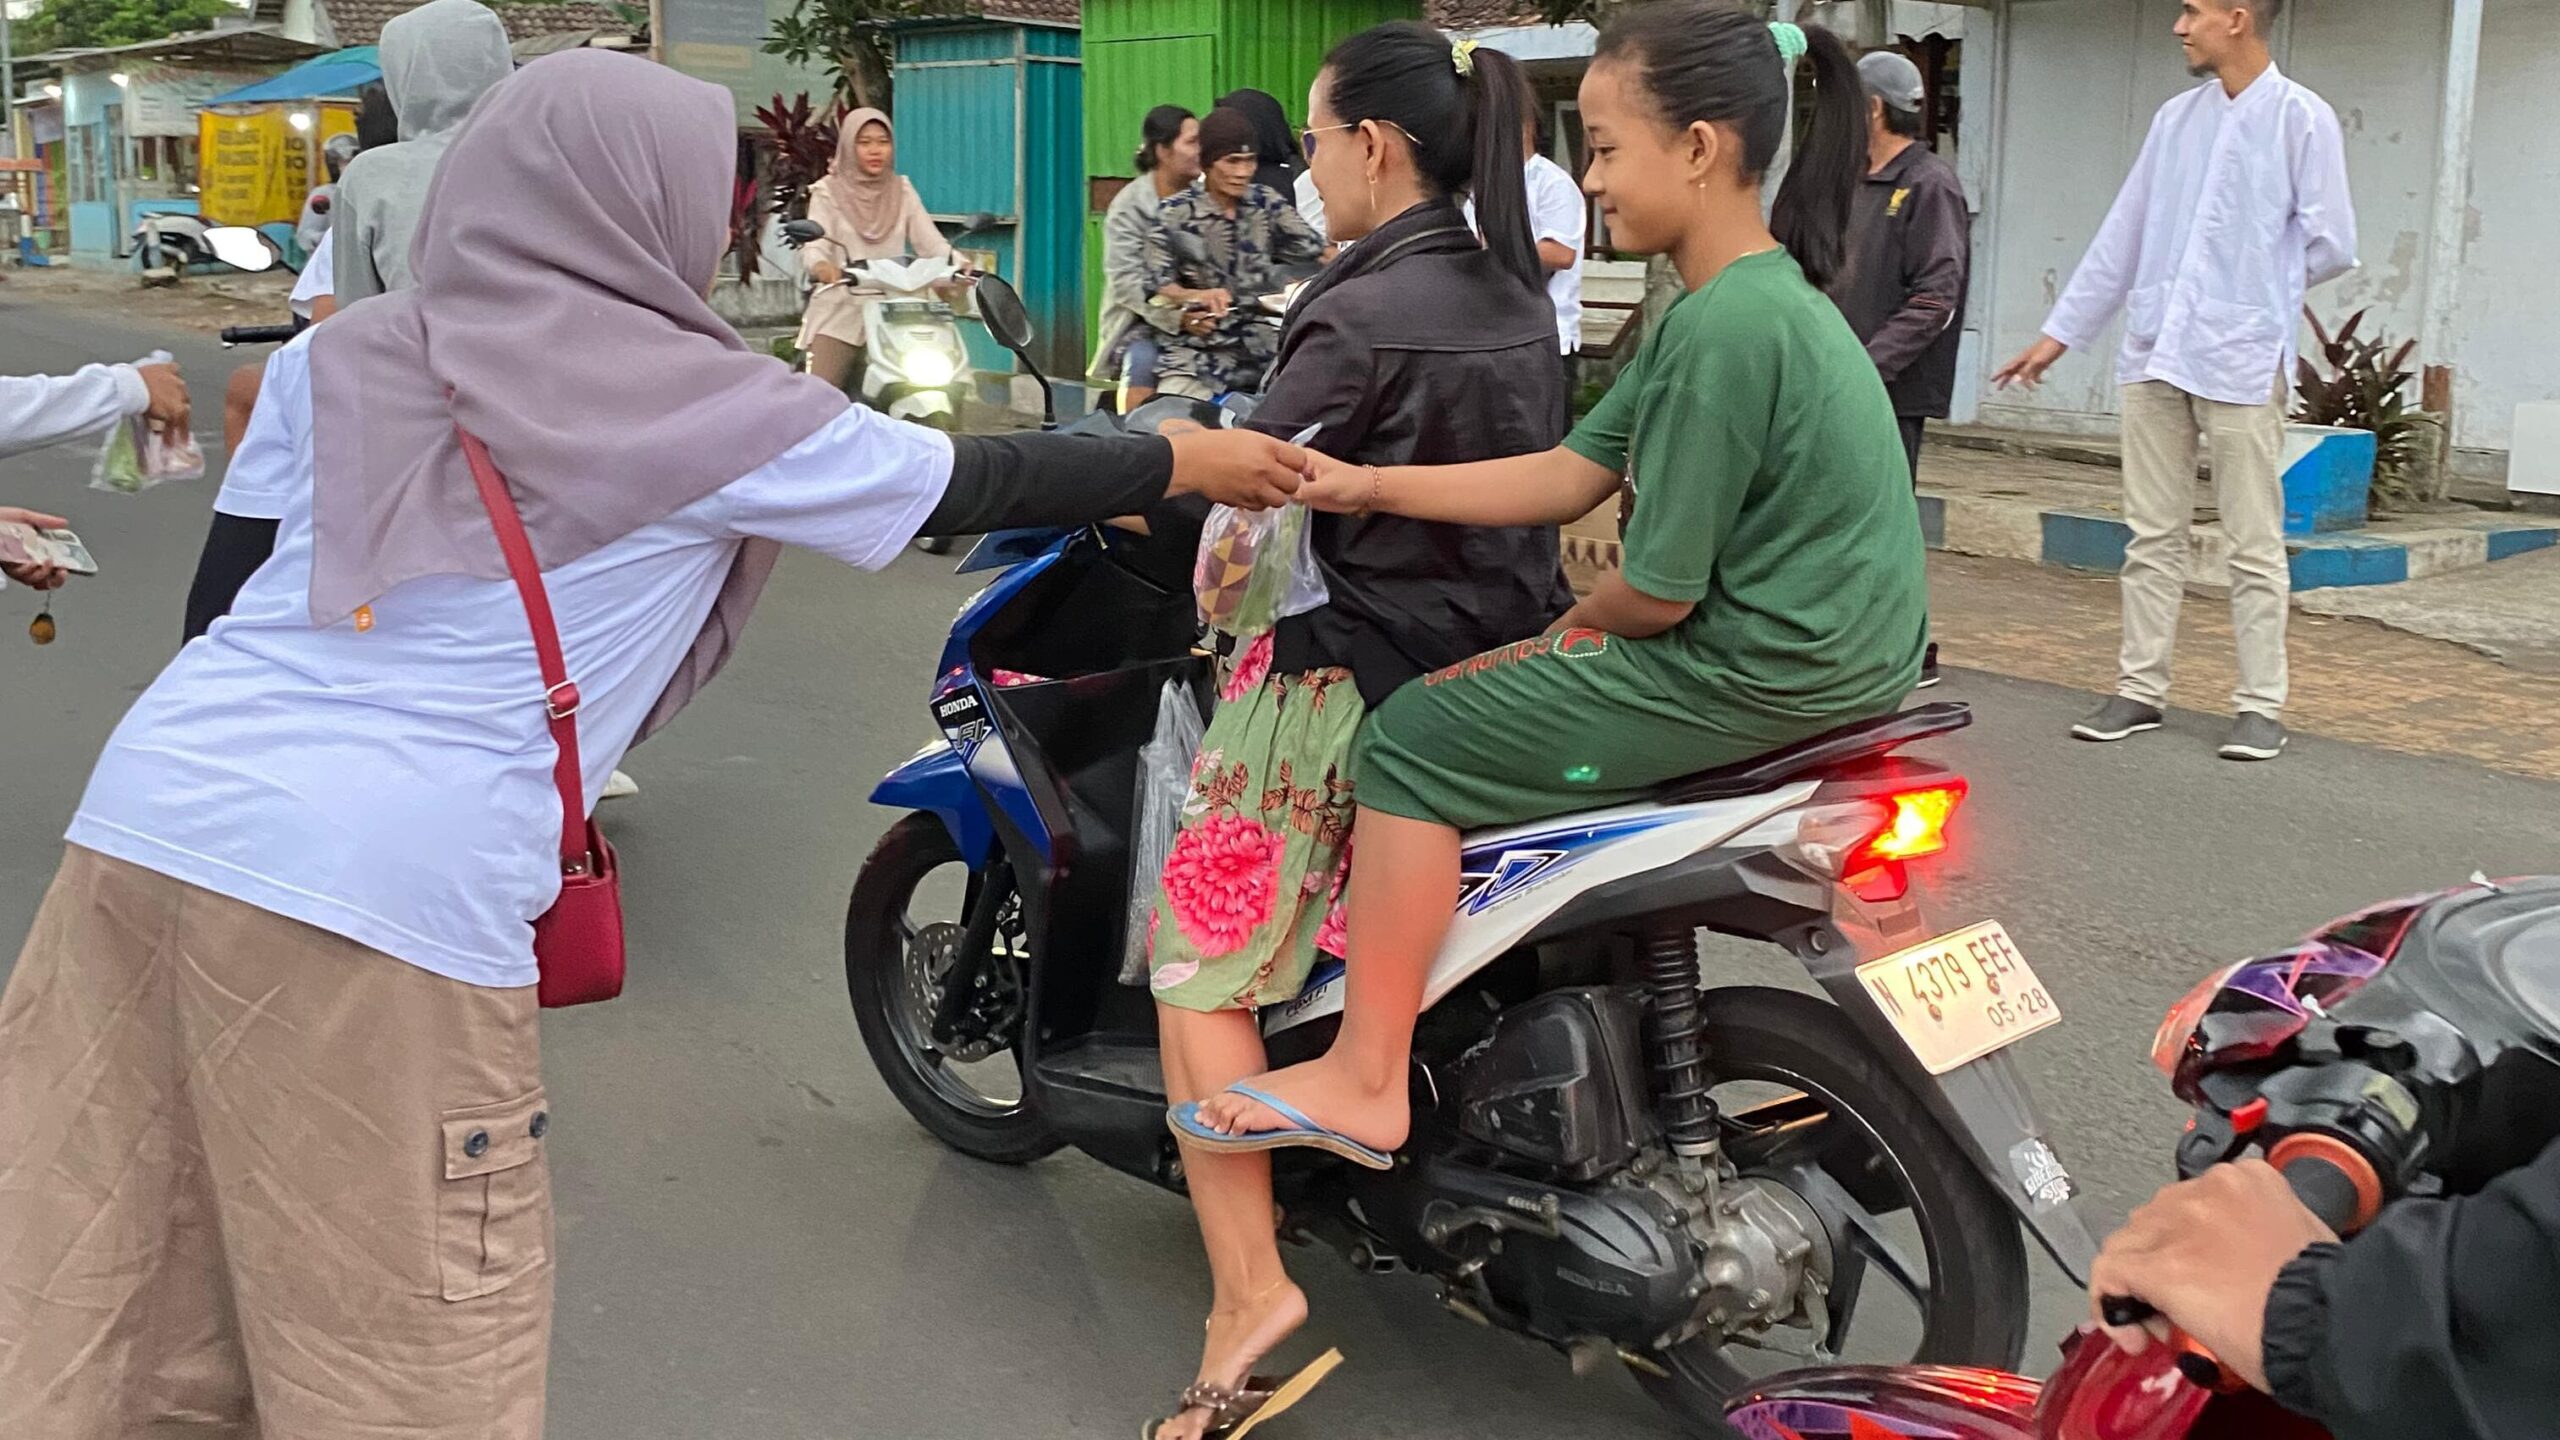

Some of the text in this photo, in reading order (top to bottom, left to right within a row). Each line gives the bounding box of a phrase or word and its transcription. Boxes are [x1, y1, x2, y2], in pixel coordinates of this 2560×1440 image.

[939, 695, 979, 718] HONDA
[957, 717, 985, 749] FI
[1871, 933, 2016, 1017] N 4379 EEF
